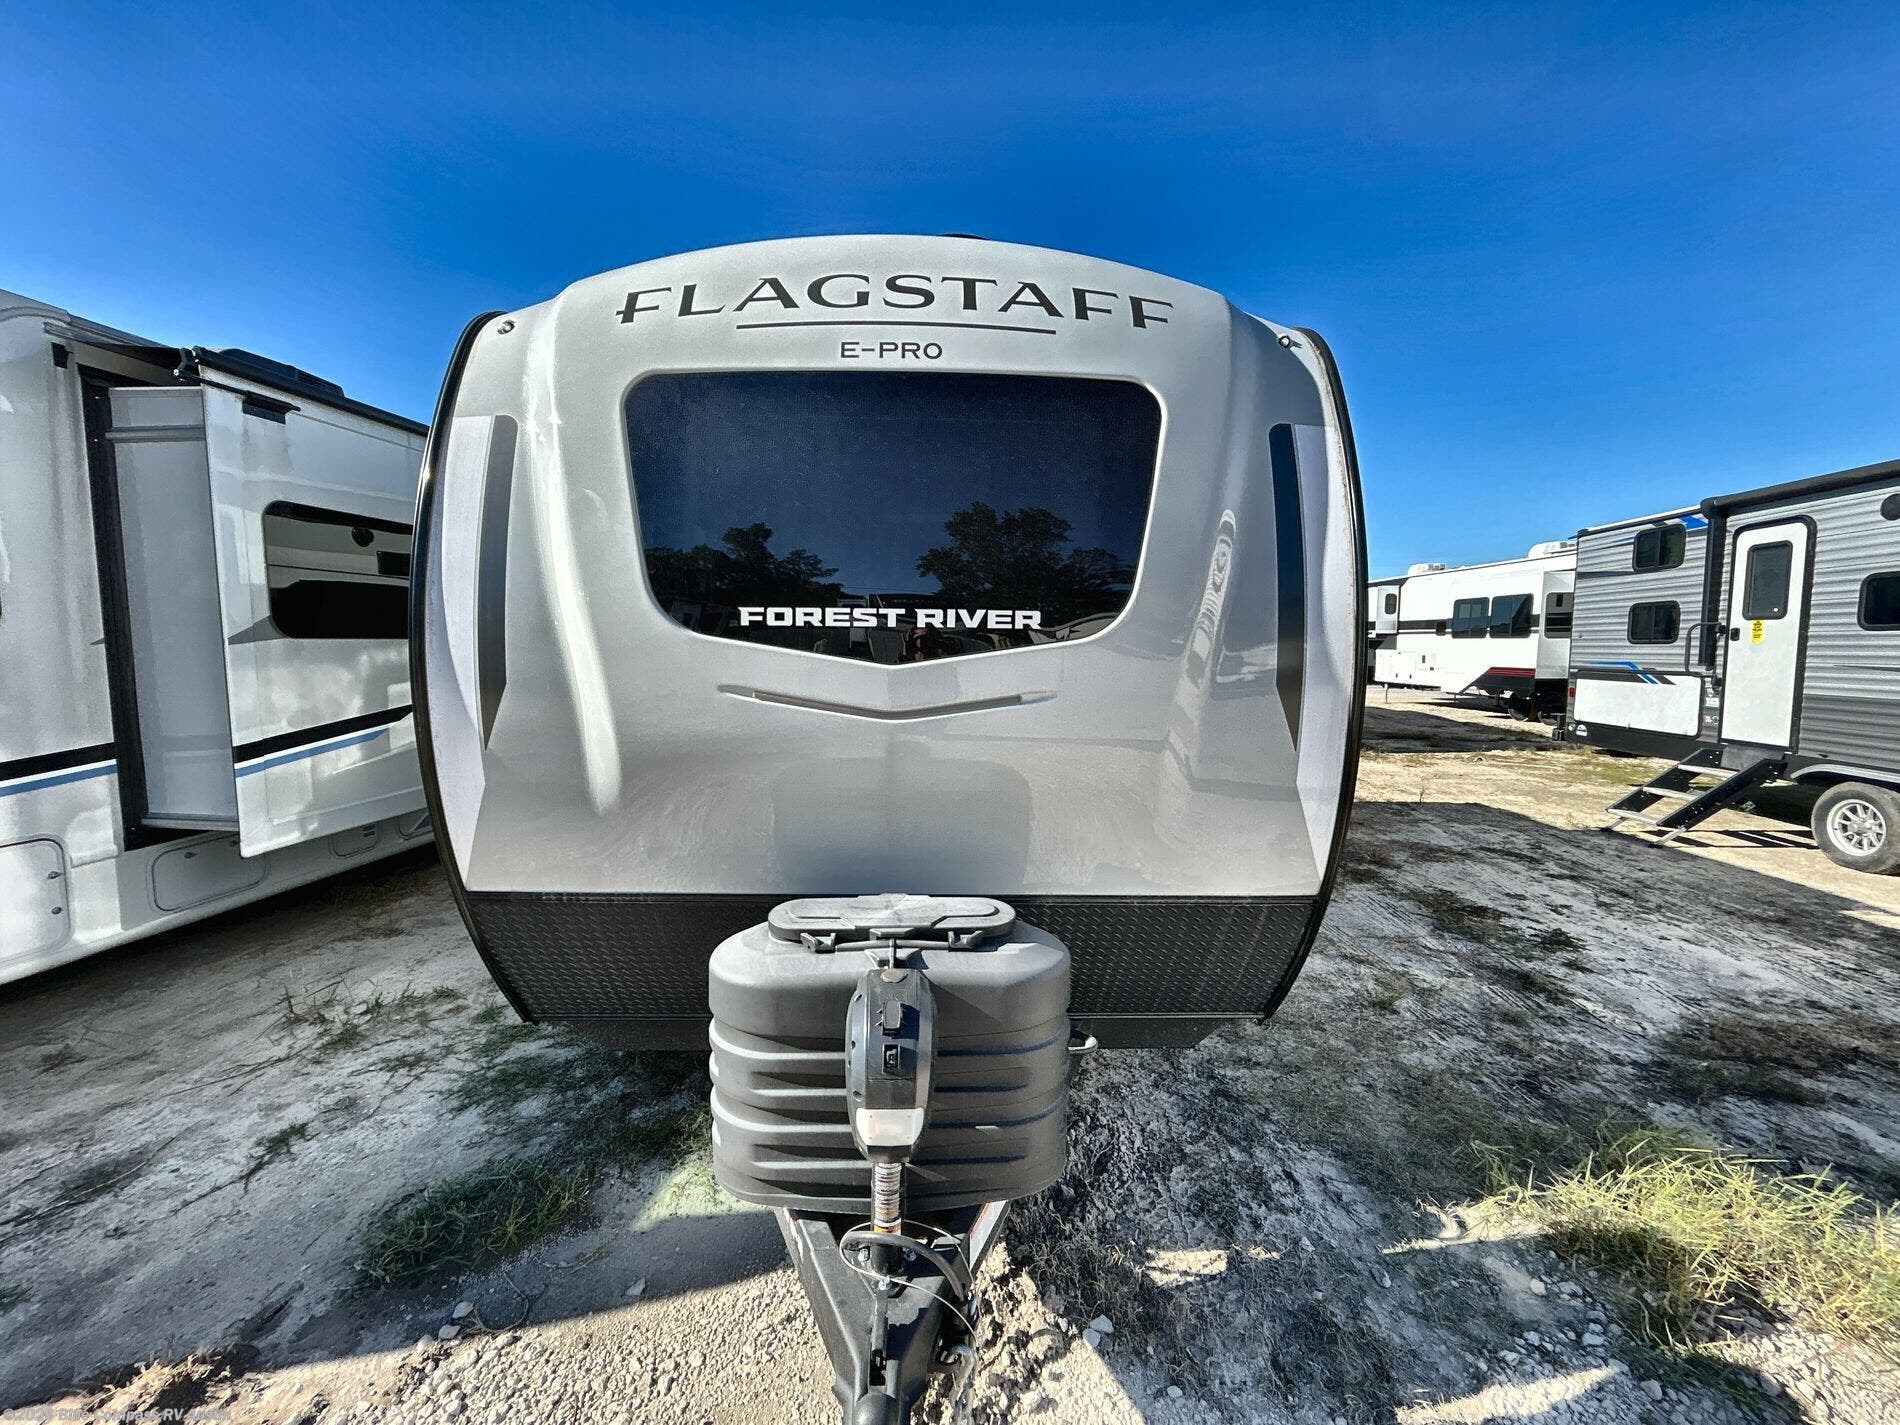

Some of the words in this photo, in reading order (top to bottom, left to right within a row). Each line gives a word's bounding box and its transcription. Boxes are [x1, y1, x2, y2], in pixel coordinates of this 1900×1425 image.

[616, 274, 1174, 328] FLAGSTAFF
[840, 341, 943, 359] E-PRO
[738, 606, 905, 627] FOREST
[915, 608, 1041, 629] RIVER
